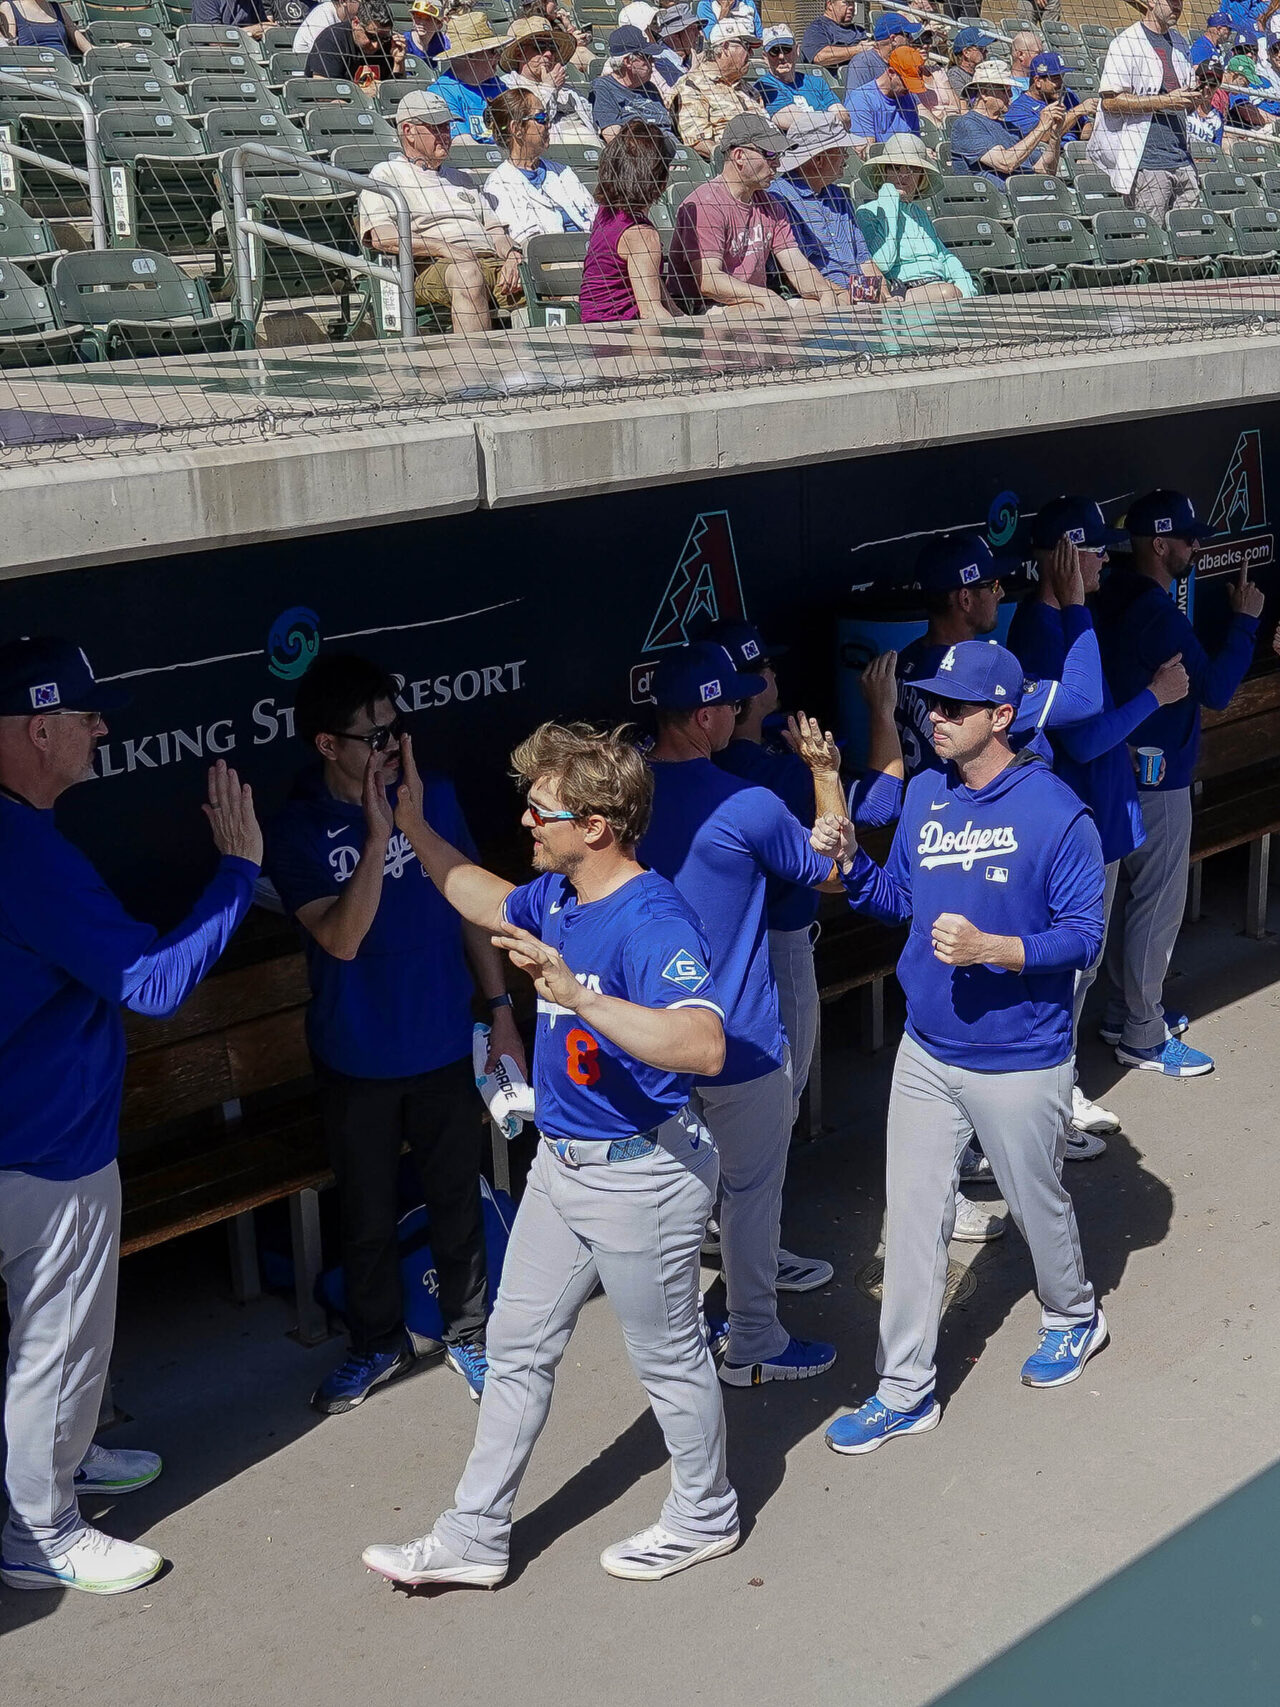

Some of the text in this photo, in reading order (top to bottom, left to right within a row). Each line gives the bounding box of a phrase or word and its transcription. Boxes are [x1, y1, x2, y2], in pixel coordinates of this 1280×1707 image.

[1197, 544, 1270, 571] dbacks.com
[91, 719, 236, 780] LKING
[918, 819, 1019, 871] Dodgers
[566, 1028, 601, 1086] 8
